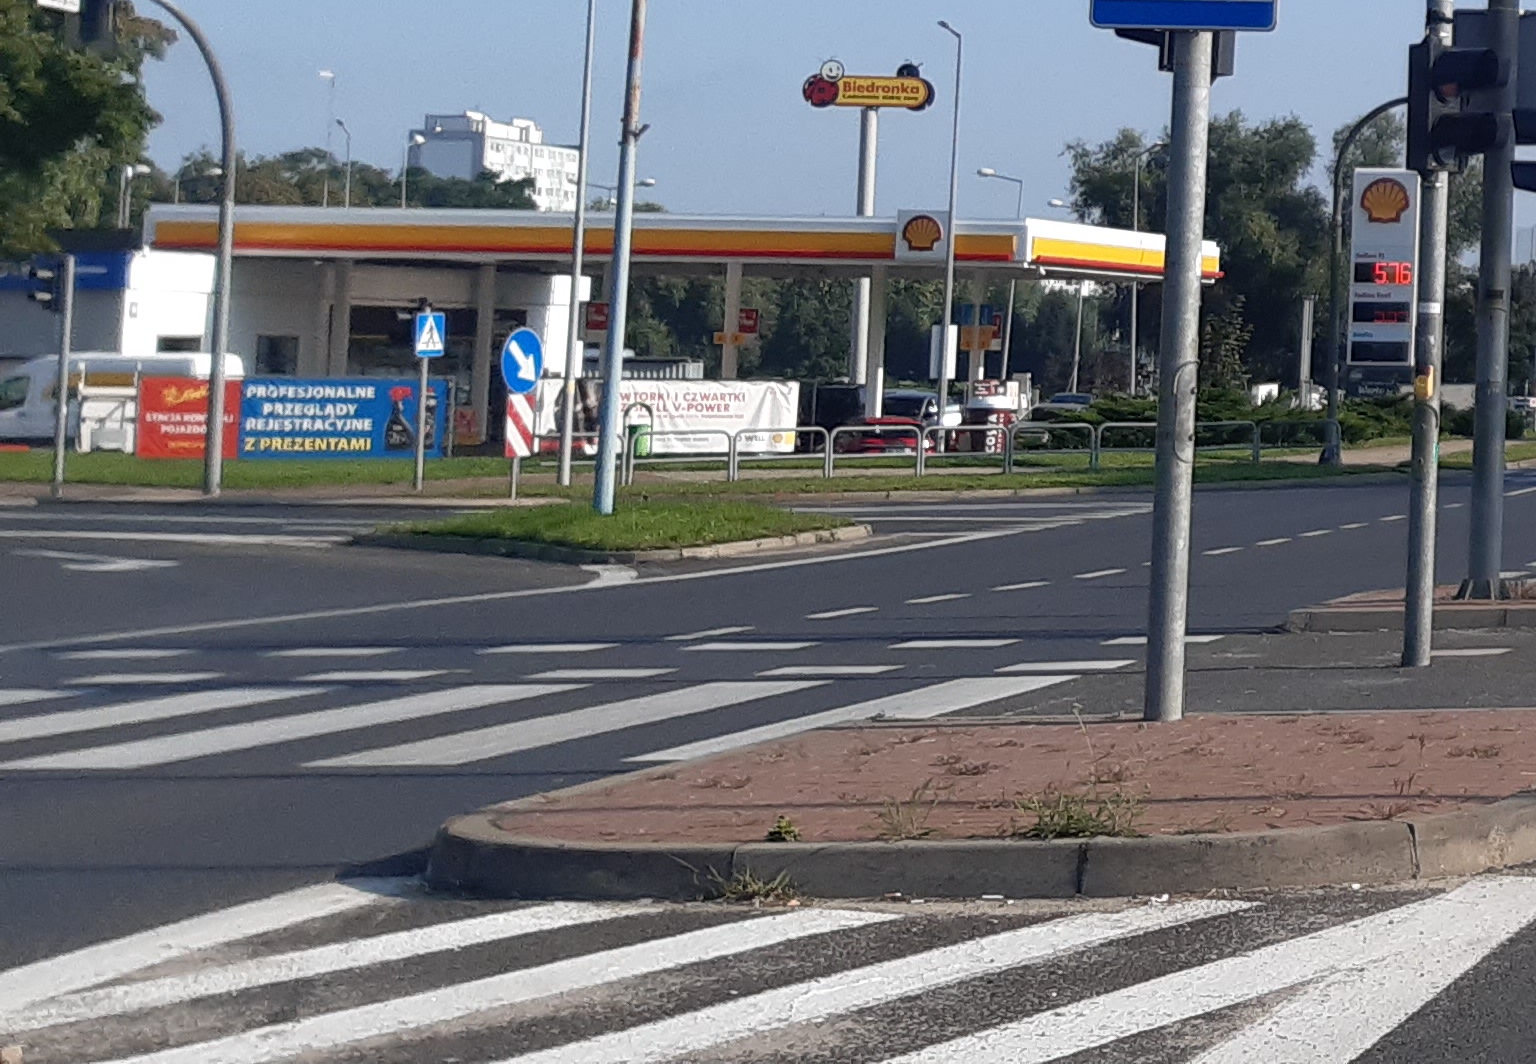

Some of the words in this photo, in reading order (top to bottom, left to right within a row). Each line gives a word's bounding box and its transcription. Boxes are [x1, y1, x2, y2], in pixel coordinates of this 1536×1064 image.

[843, 81, 920, 95] Biedronka
[246, 386, 376, 399] PROFESJONALNE
[620, 392, 670, 402] WTORKI
[683, 392, 746, 403] CZWARTKI
[262, 403, 358, 418] PRZEGLĄDY
[673, 403, 731, 413] V-POWER
[245, 418, 372, 431] REJESTRACYJNE
[244, 437, 255, 452] Z
[259, 438, 371, 452] PREZENTAMI
